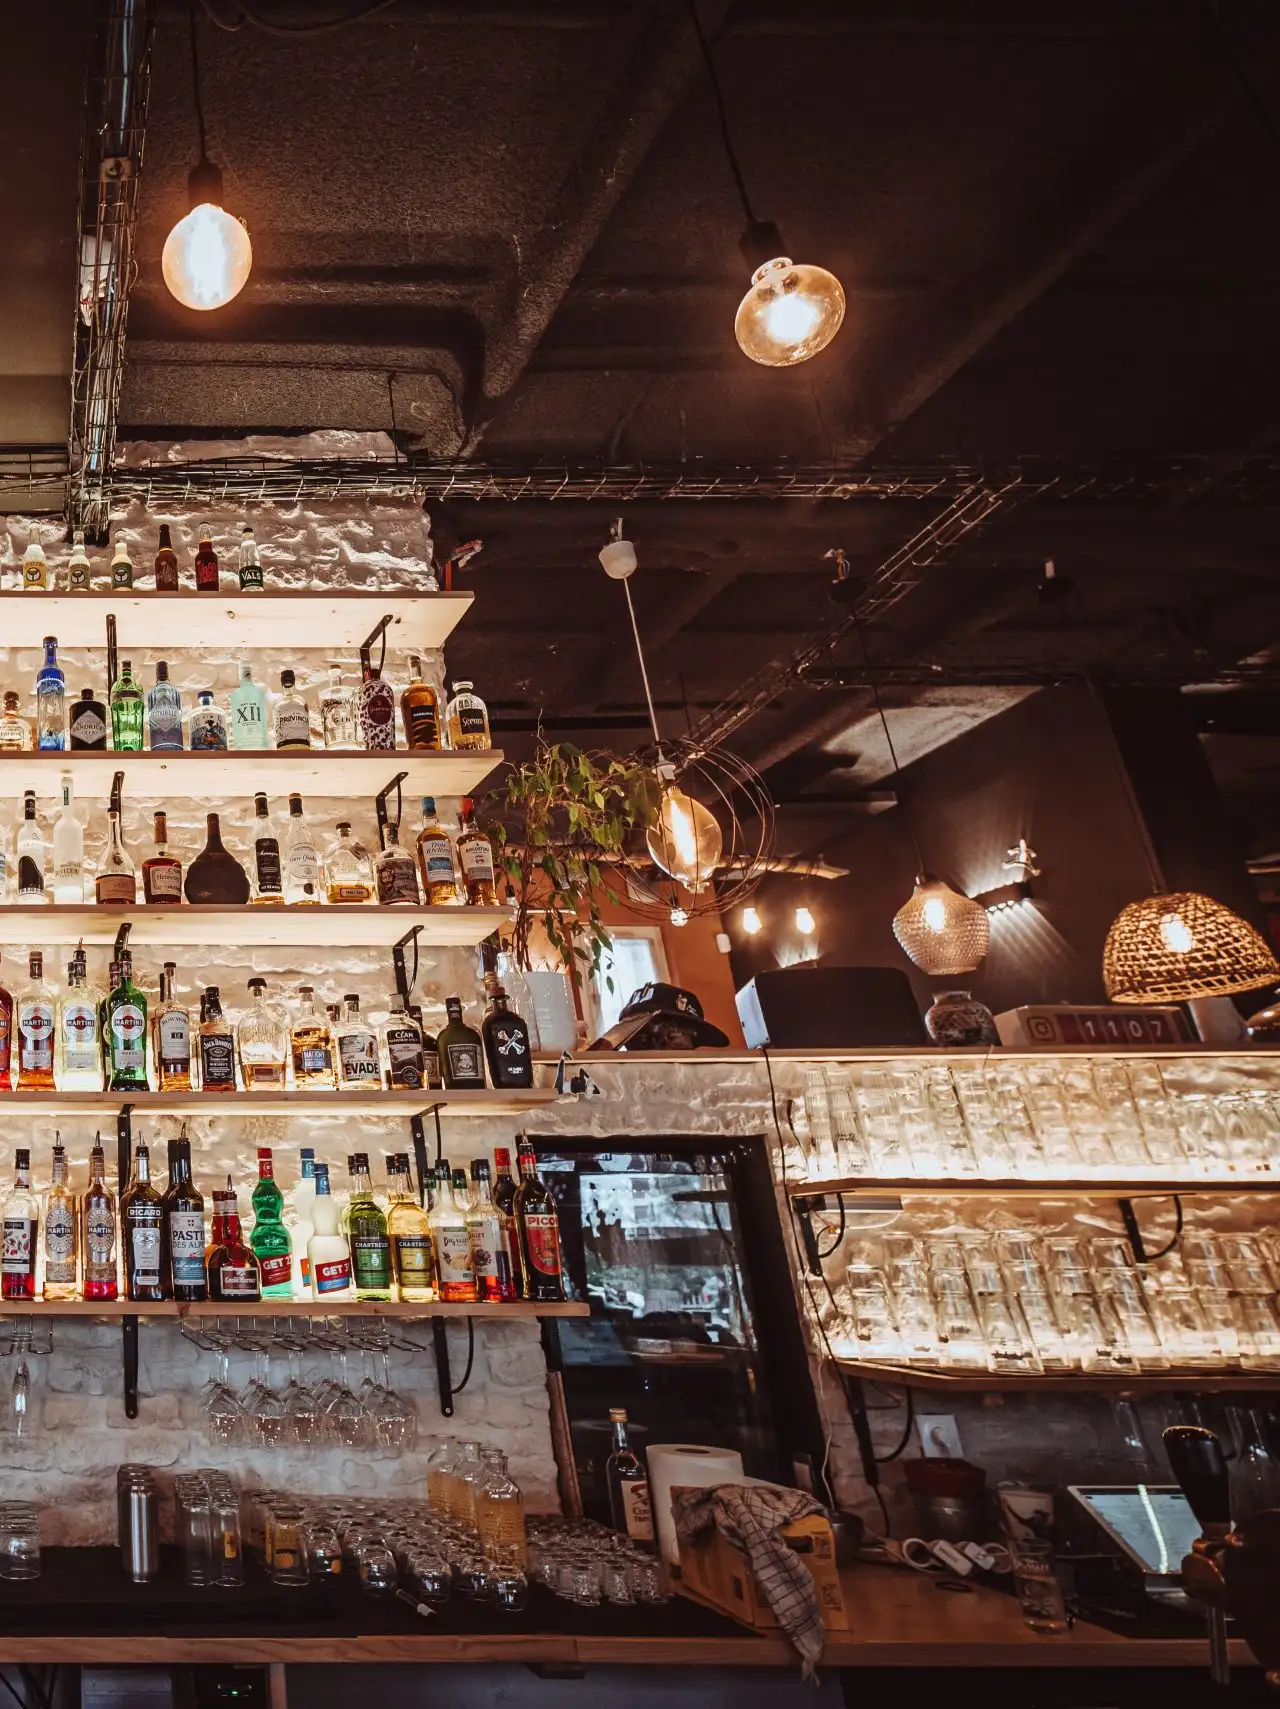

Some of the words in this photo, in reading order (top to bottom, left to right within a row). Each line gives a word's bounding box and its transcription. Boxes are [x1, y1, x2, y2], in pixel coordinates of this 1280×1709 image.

[242, 571, 261, 581] VALS
[237, 706, 261, 723] XII
[1085, 1020, 1162, 1037] 1107
[528, 1217, 556, 1226] PICO
[173, 1231, 204, 1240] PASTI
[263, 1258, 283, 1270] GET
[322, 1265, 342, 1277] GET
